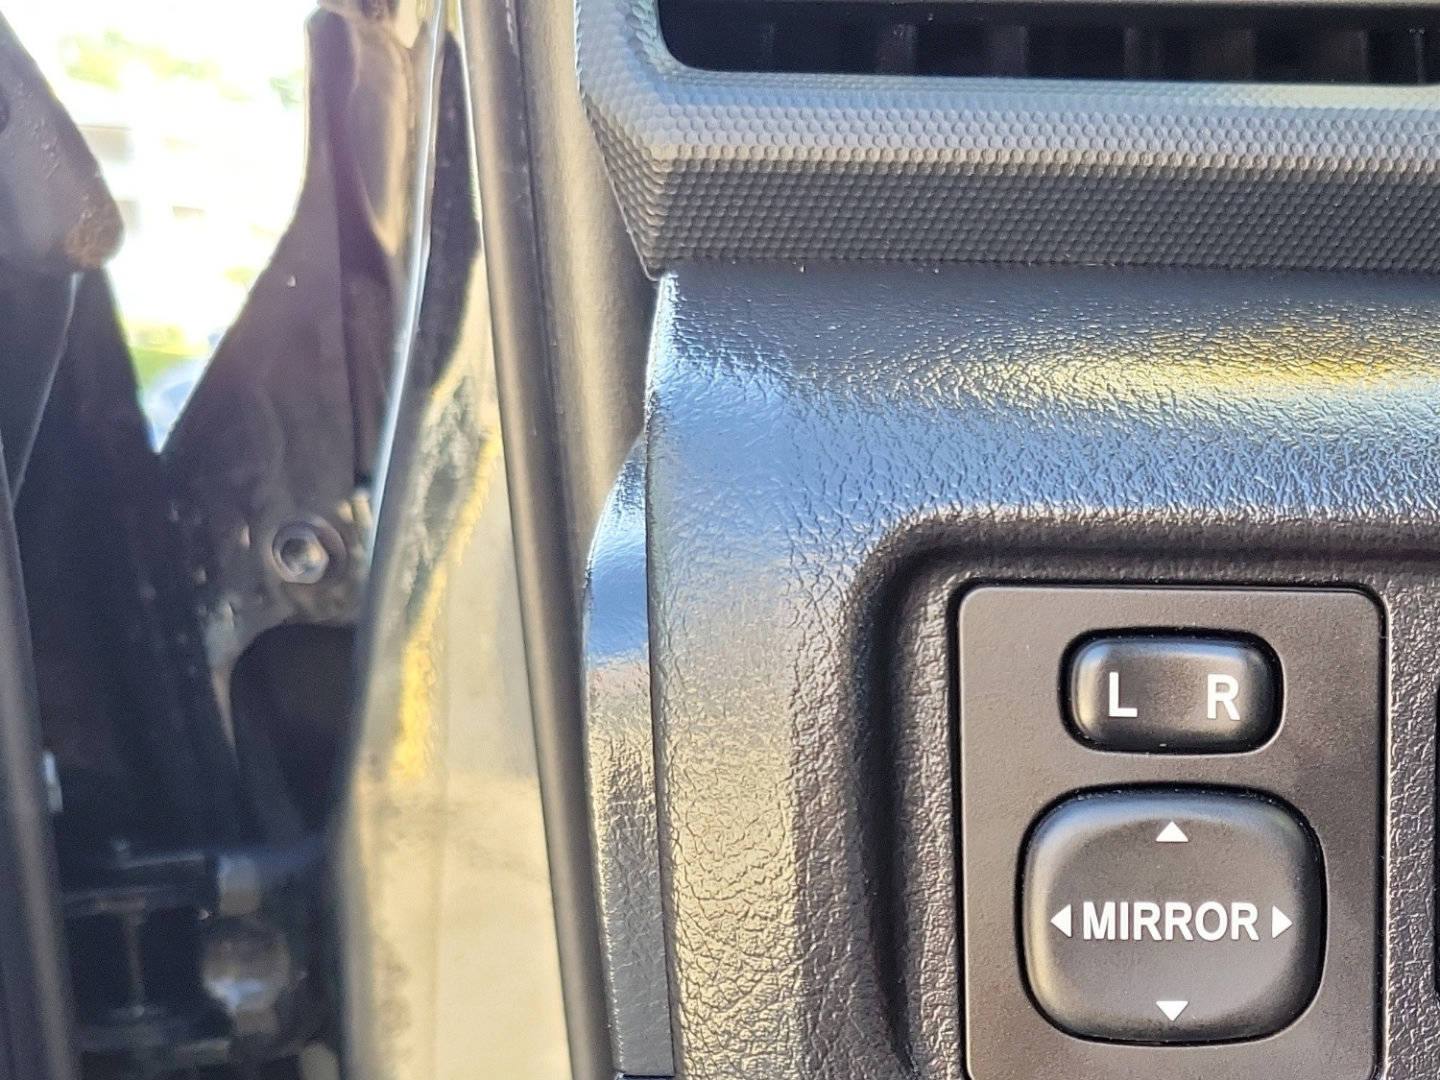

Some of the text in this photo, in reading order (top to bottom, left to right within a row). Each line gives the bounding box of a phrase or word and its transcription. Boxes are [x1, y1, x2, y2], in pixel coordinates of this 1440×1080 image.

[1108, 671, 1241, 721] L R
[1083, 901, 1260, 942] MIRROR
